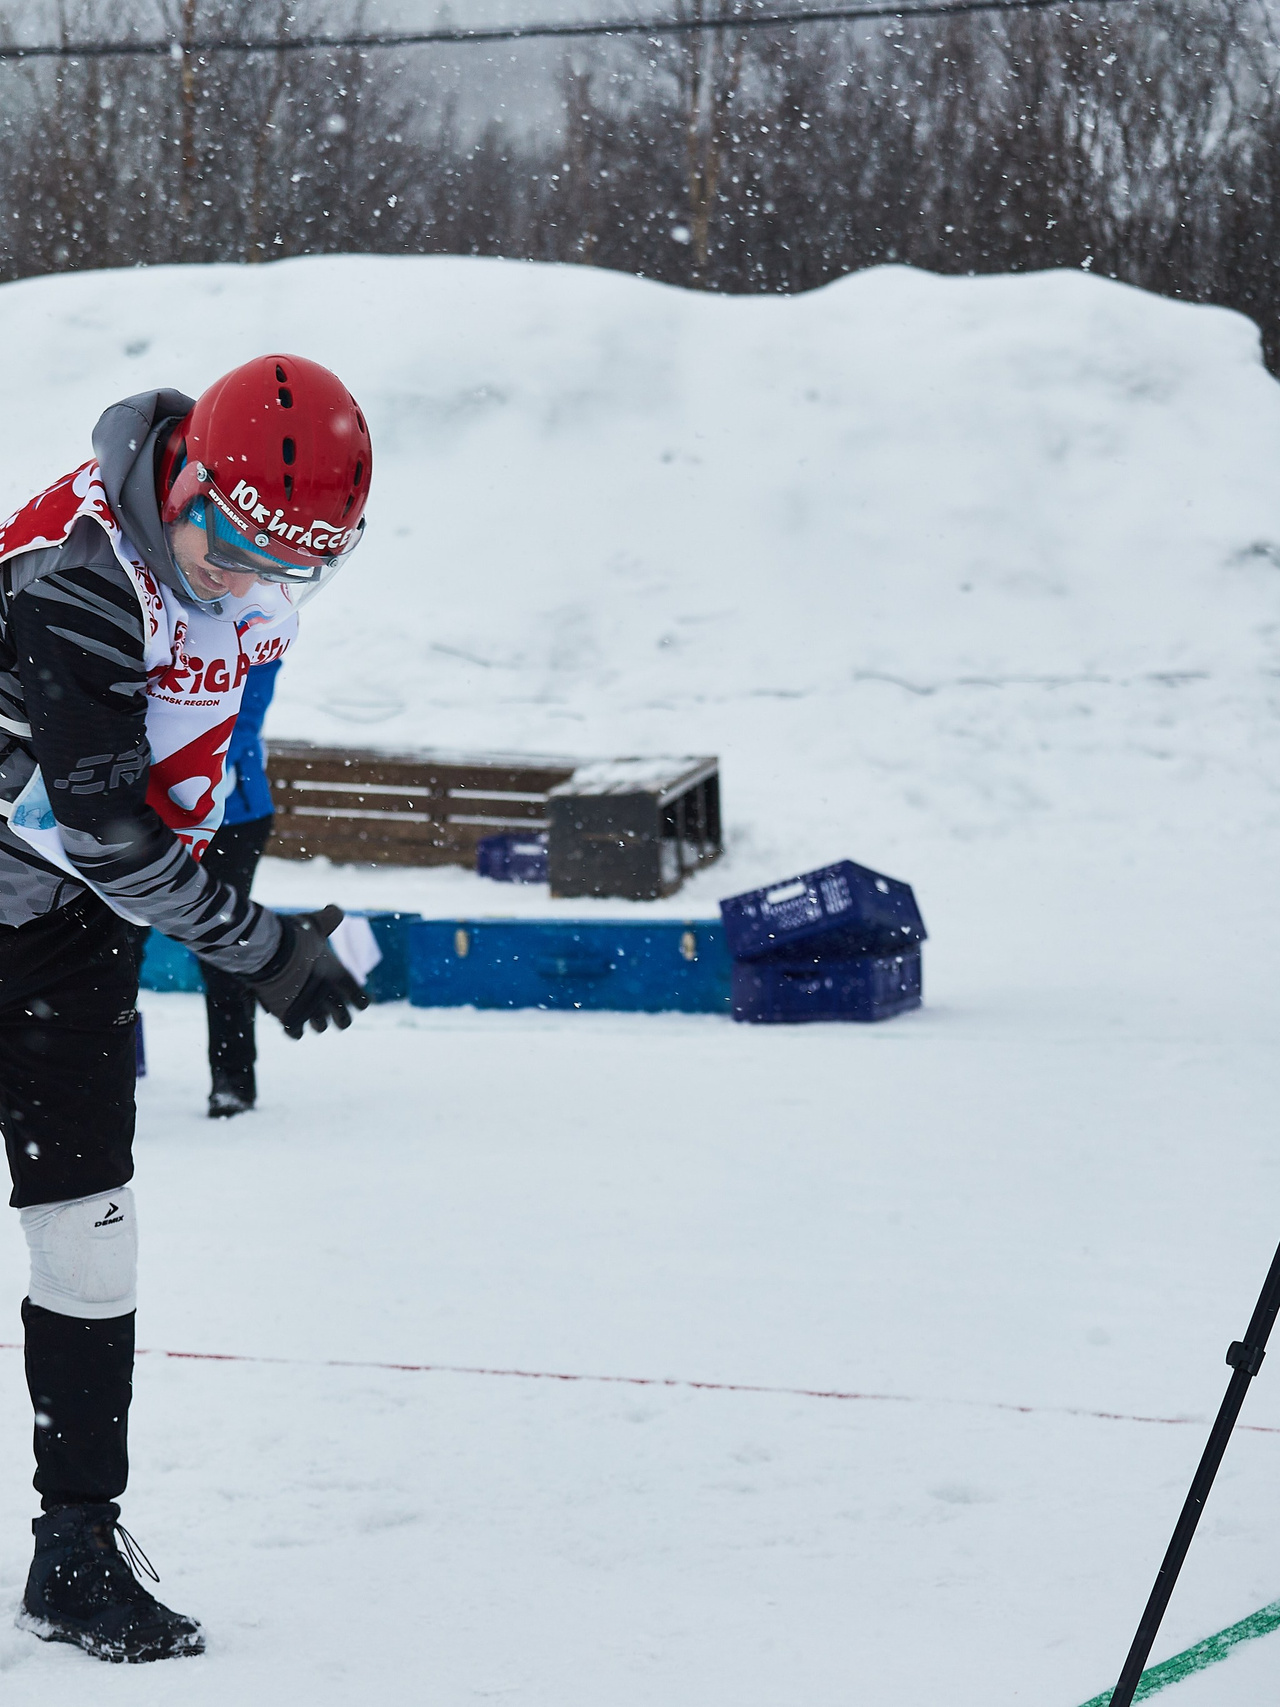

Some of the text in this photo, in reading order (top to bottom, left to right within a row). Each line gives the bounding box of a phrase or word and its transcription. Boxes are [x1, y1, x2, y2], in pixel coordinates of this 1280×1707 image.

[208, 488, 250, 531] МУРМАНСК
[183, 699, 220, 707] REGION
[94, 1215, 124, 1228] DEMIX
